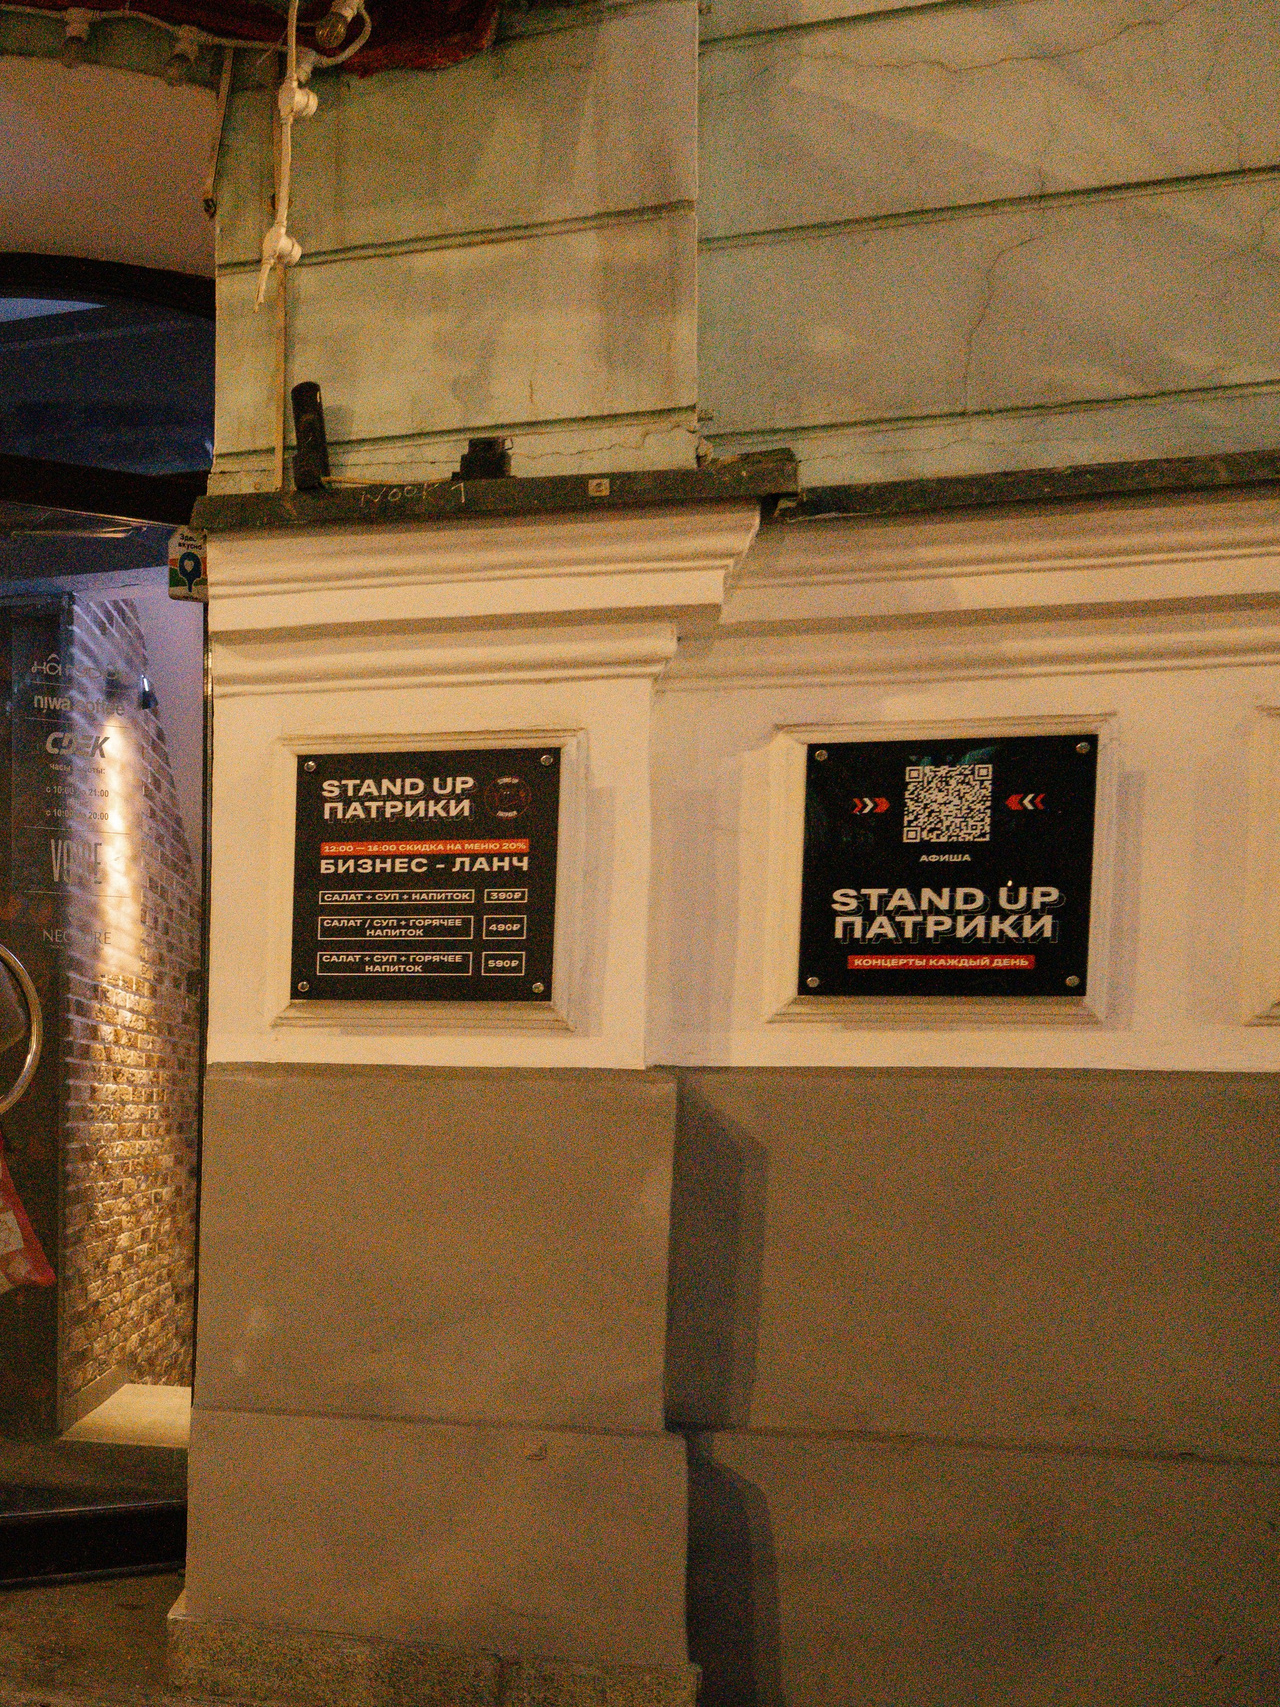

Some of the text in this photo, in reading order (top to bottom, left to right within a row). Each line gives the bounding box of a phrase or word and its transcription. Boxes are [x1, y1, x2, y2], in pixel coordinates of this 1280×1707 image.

[321, 776, 474, 797] STAND UP
[323, 799, 470, 819] ПАТРИКИ
[323, 845, 354, 853] 12:00
[399, 843, 445, 852] СКИДКА
[447, 843, 463, 851] НА
[464, 842, 500, 851] МЕНЮ
[502, 842, 527, 850] 20%
[920, 854, 971, 862] АФИША
[320, 857, 428, 874] БИЗНЕС
[452, 856, 529, 873] ЛАНЧ
[323, 893, 364, 901] САЛАТ
[375, 893, 400, 901] СУП
[411, 892, 470, 900] НАПИТОК
[831, 886, 1060, 911] STAND UP
[323, 919, 363, 927] САЛАТ
[373, 919, 397, 927] СУП
[409, 919, 462, 927] ГОРЯЧЕЕ
[834, 915, 1053, 938] ПАТРИКИ
[366, 929, 424, 937] НАПИТОК
[322, 955, 362, 963] САЛАТ
[373, 955, 397, 963] СУП
[854, 957, 1029, 967] КОНЦЕРТЫ КАЖДЫЙ ДЕНЬ
